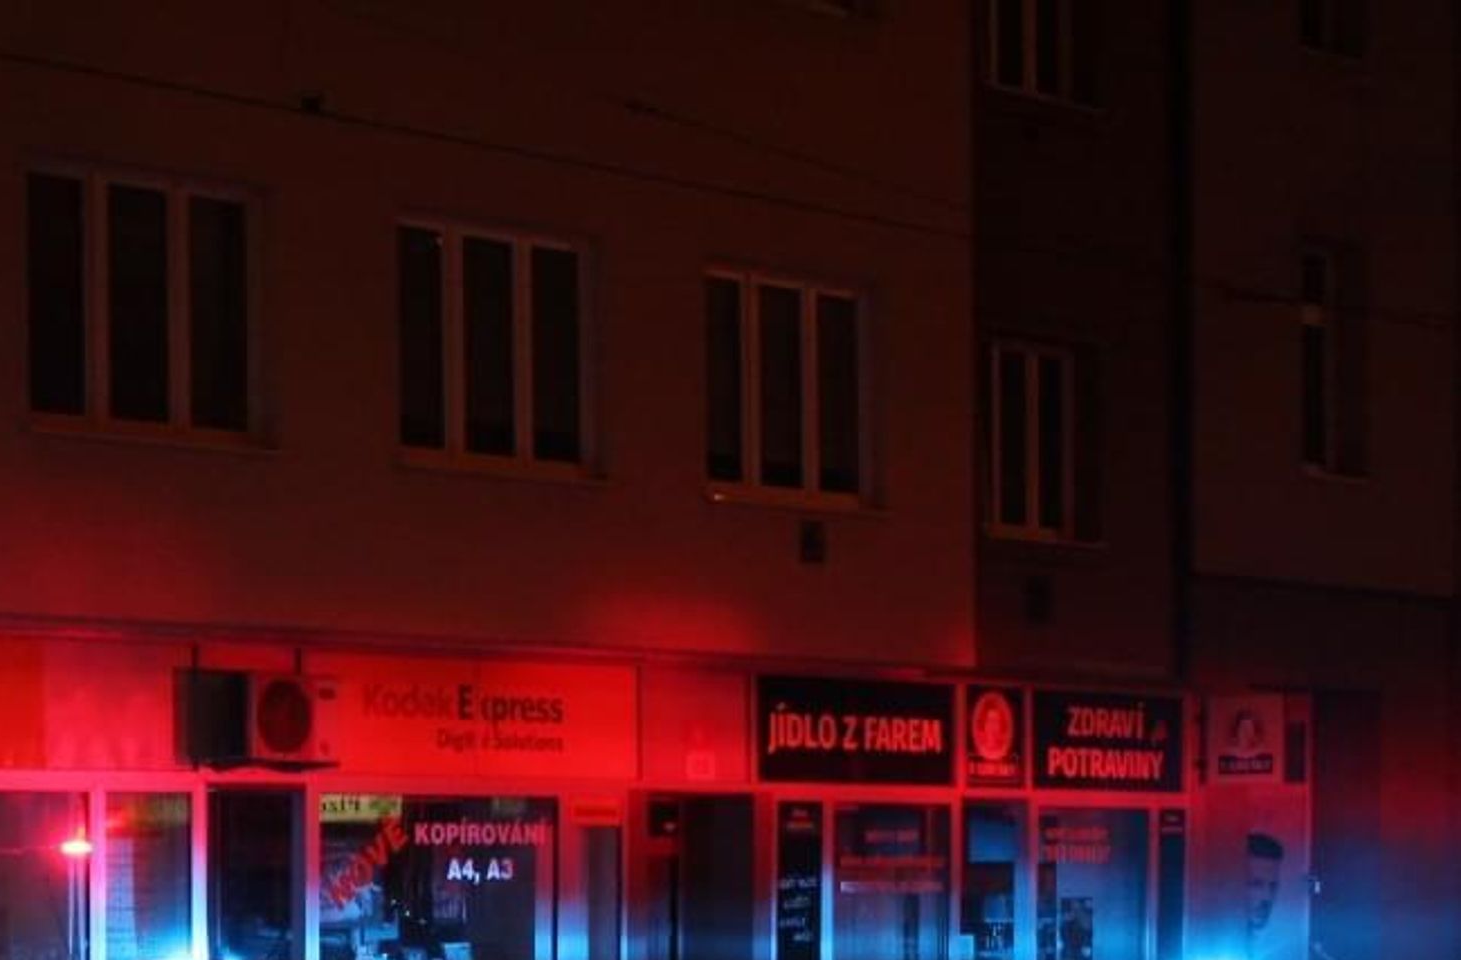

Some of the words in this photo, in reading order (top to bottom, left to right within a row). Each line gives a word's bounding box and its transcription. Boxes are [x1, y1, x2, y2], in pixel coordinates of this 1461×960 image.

[364, 683, 456, 719] Kodak
[768, 703, 837, 754] JÍDLO
[842, 715, 858, 751] Z
[863, 719, 943, 753] FAREM
[1066, 701, 1143, 739] ZDRAVÍ
[1047, 745, 1165, 779] POTRAVINY
[414, 816, 548, 846] KOPÍROVÁNÍ
[447, 857, 480, 884] A4,
[487, 858, 514, 881] A3
